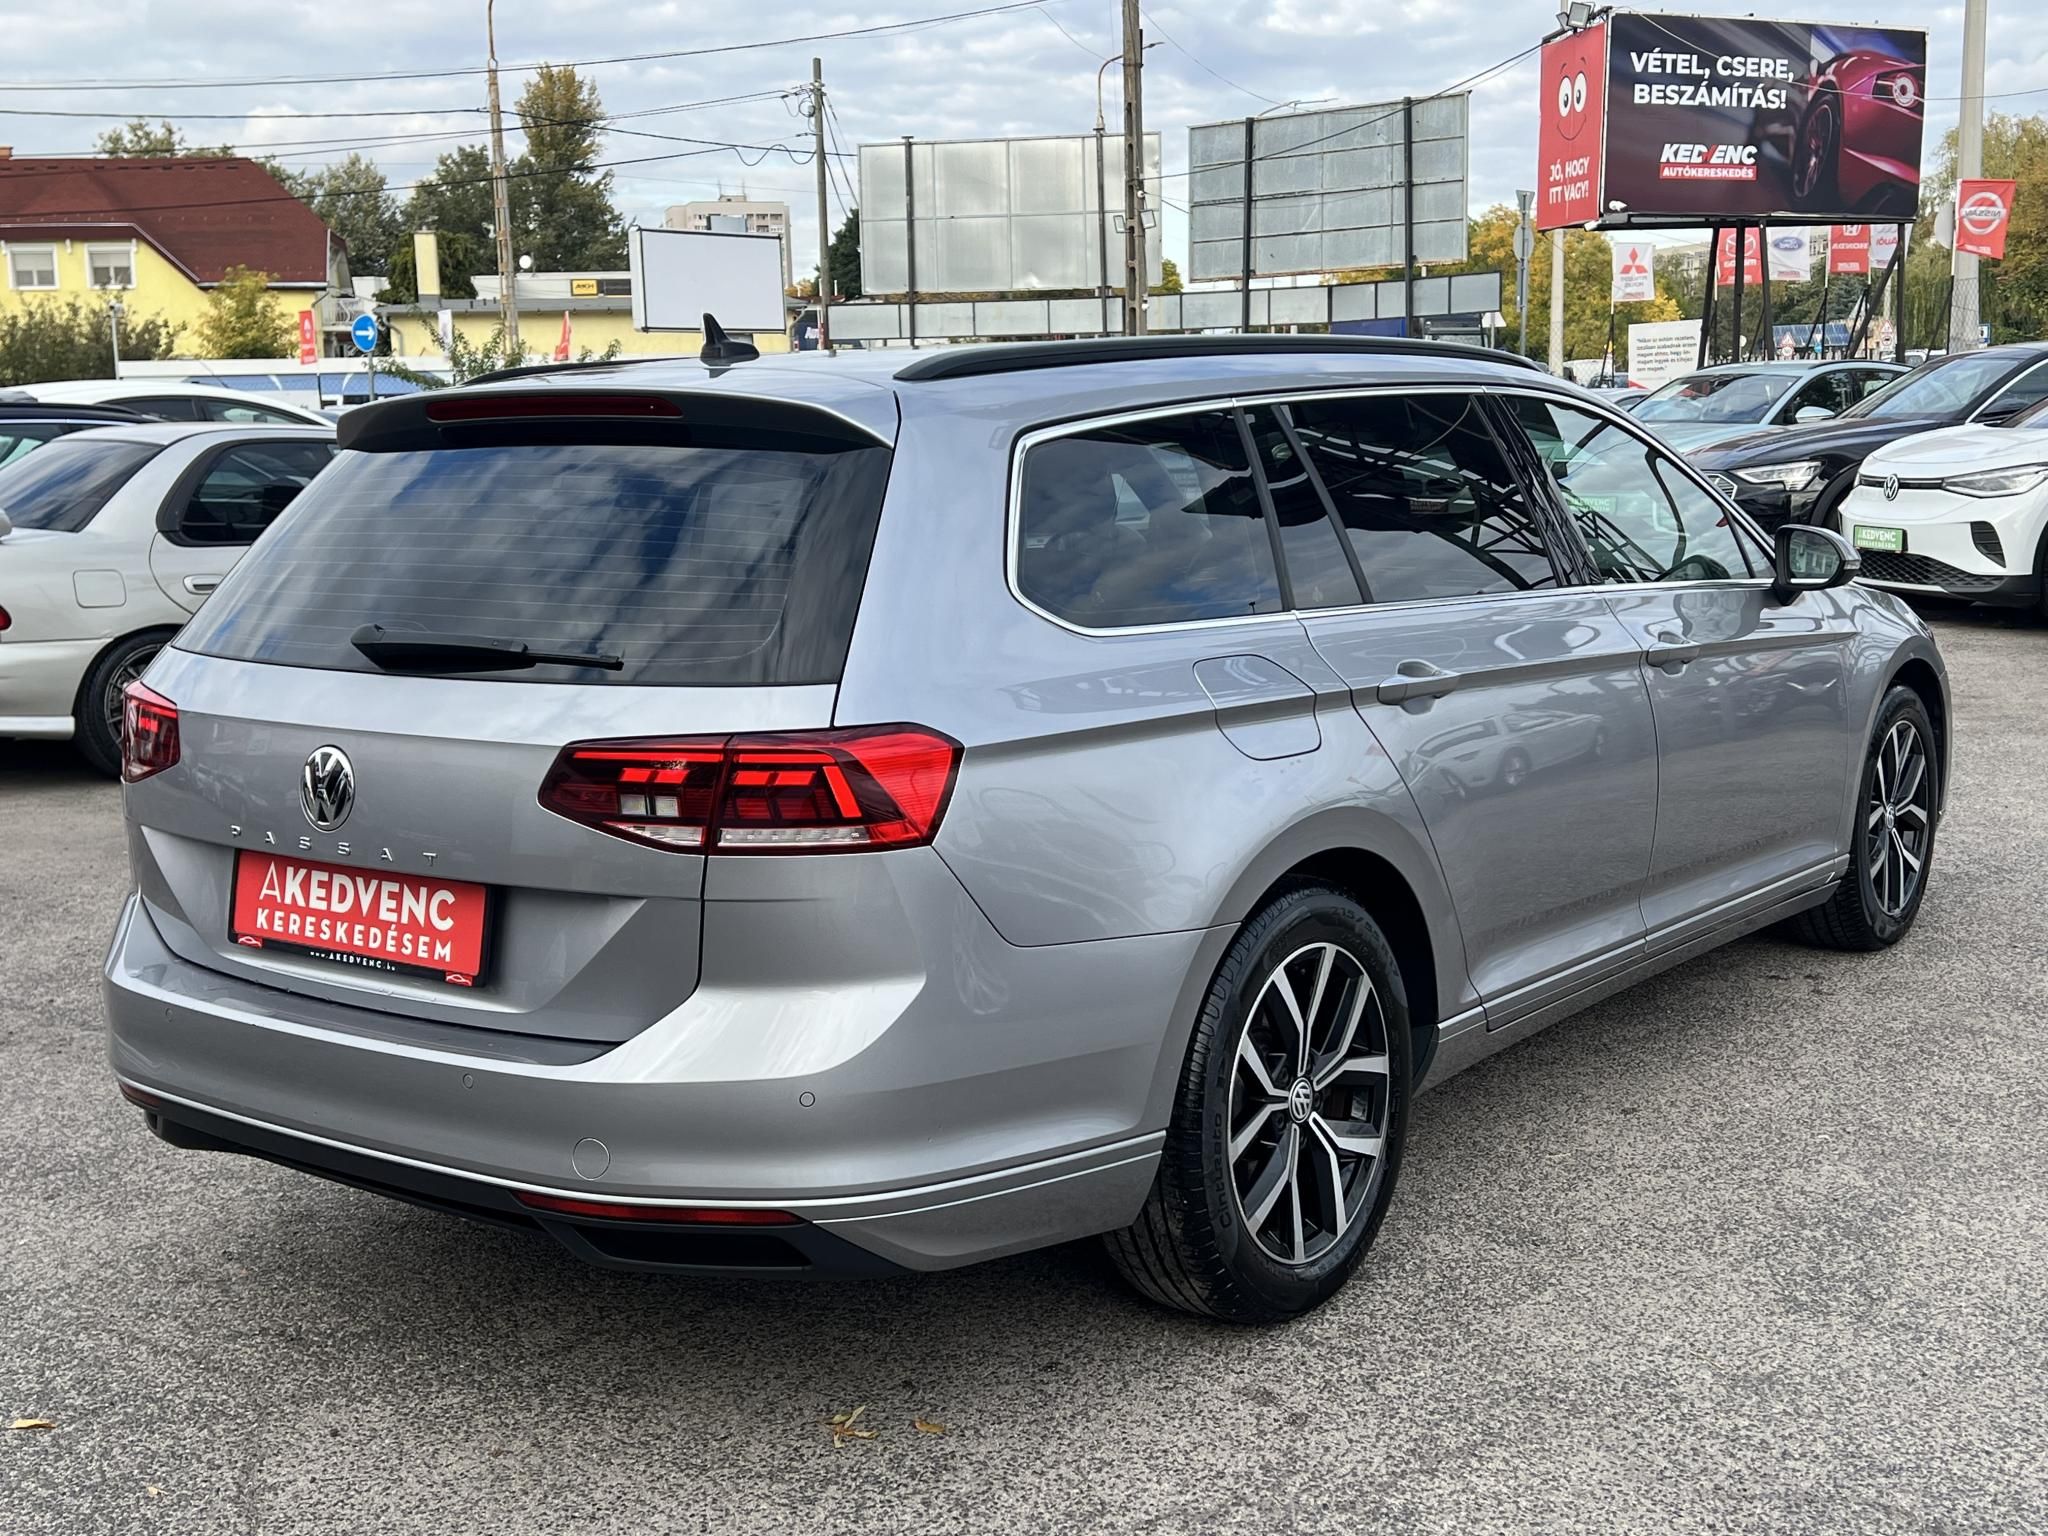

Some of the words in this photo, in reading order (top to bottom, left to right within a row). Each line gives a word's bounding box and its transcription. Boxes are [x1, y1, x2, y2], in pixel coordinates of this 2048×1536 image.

[1630, 47, 1711, 79] VÉTEL,
[1716, 55, 1795, 83] CSERE,
[1633, 81, 1788, 109] BESZÁMÍTÁS!
[1550, 163, 1563, 182] JÓ,
[1565, 156, 1590, 176] HOGY
[1662, 165, 1755, 178] AUTÓKERESKEDÉS
[1549, 187, 1562, 204] ITT
[1564, 180, 1590, 201] VAGY!
[230, 825, 438, 867] PASSAT
[259, 861, 456, 931] AKEDVENC
[256, 908, 452, 962] KERESKEDÉSEM
